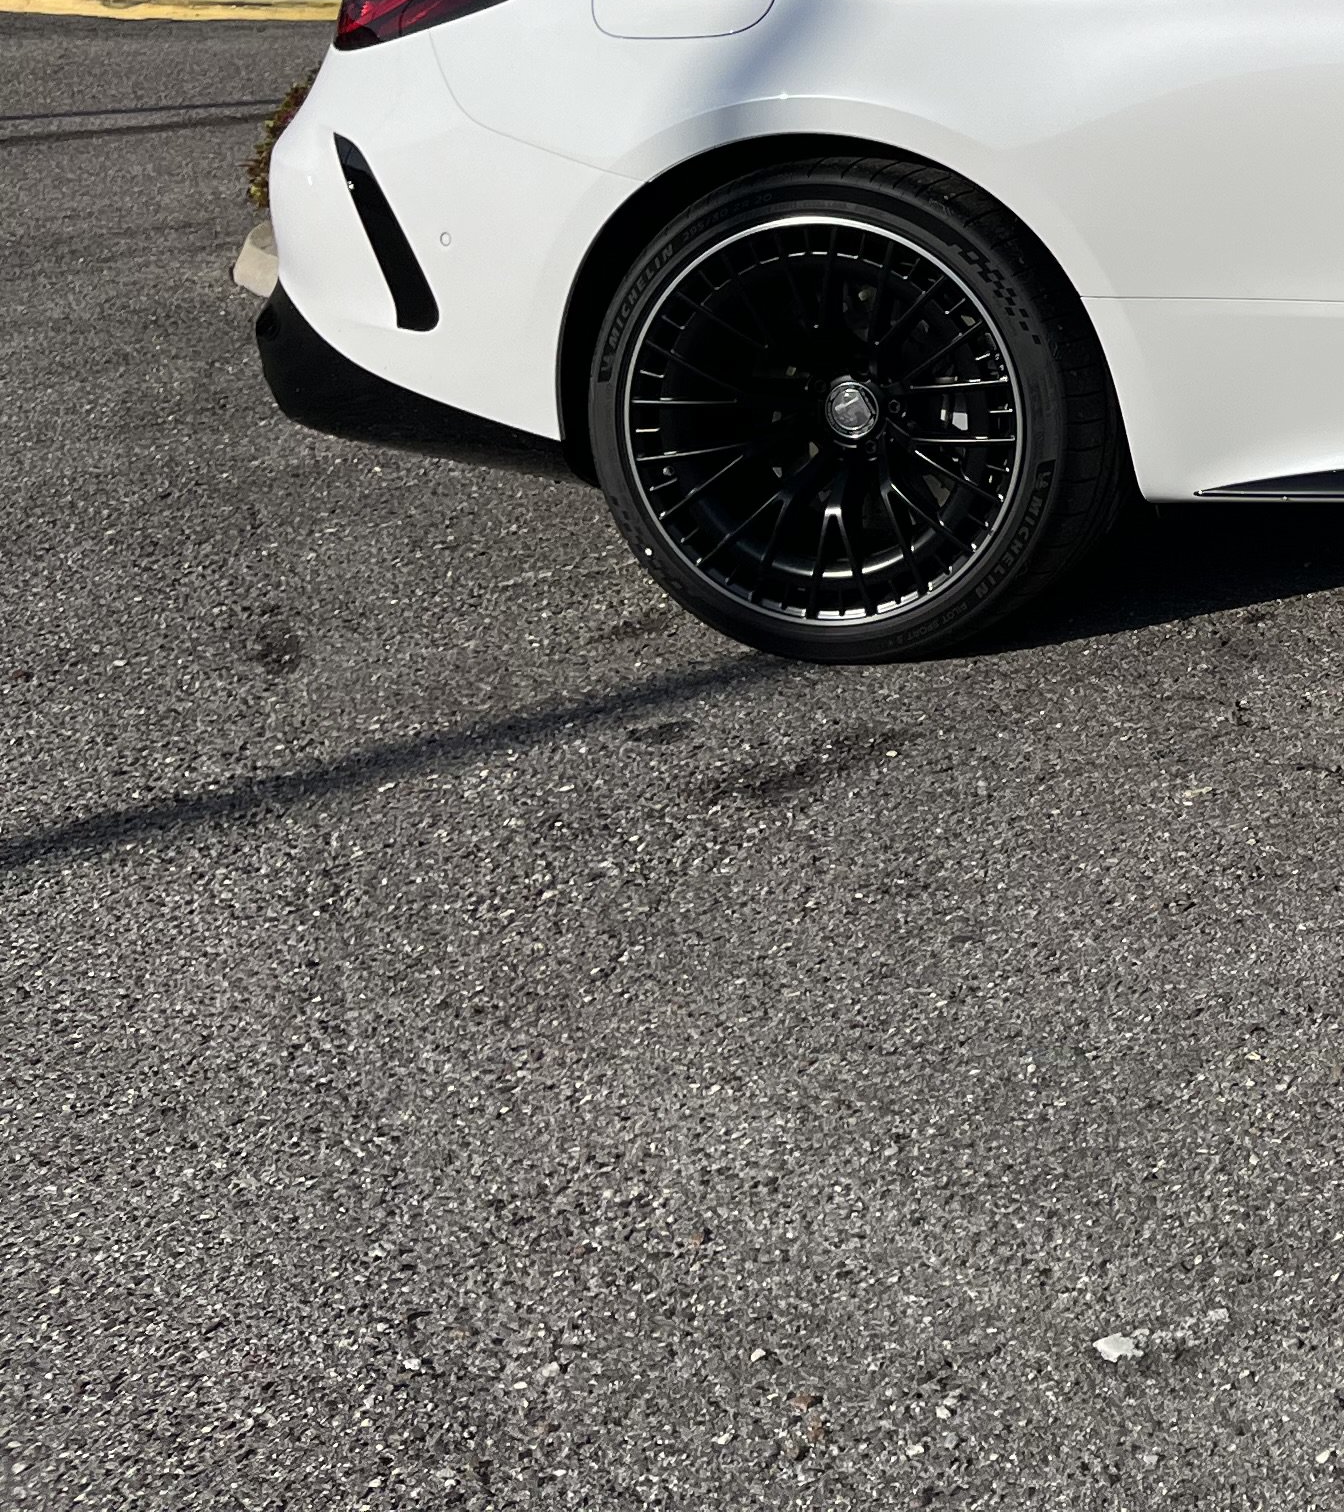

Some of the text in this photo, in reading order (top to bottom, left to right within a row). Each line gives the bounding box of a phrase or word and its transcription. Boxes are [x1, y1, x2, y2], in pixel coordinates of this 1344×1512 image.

[606, 241, 678, 349] MICHELIN
[972, 494, 1044, 598] MICHELIN
[938, 600, 969, 625] PILOT
